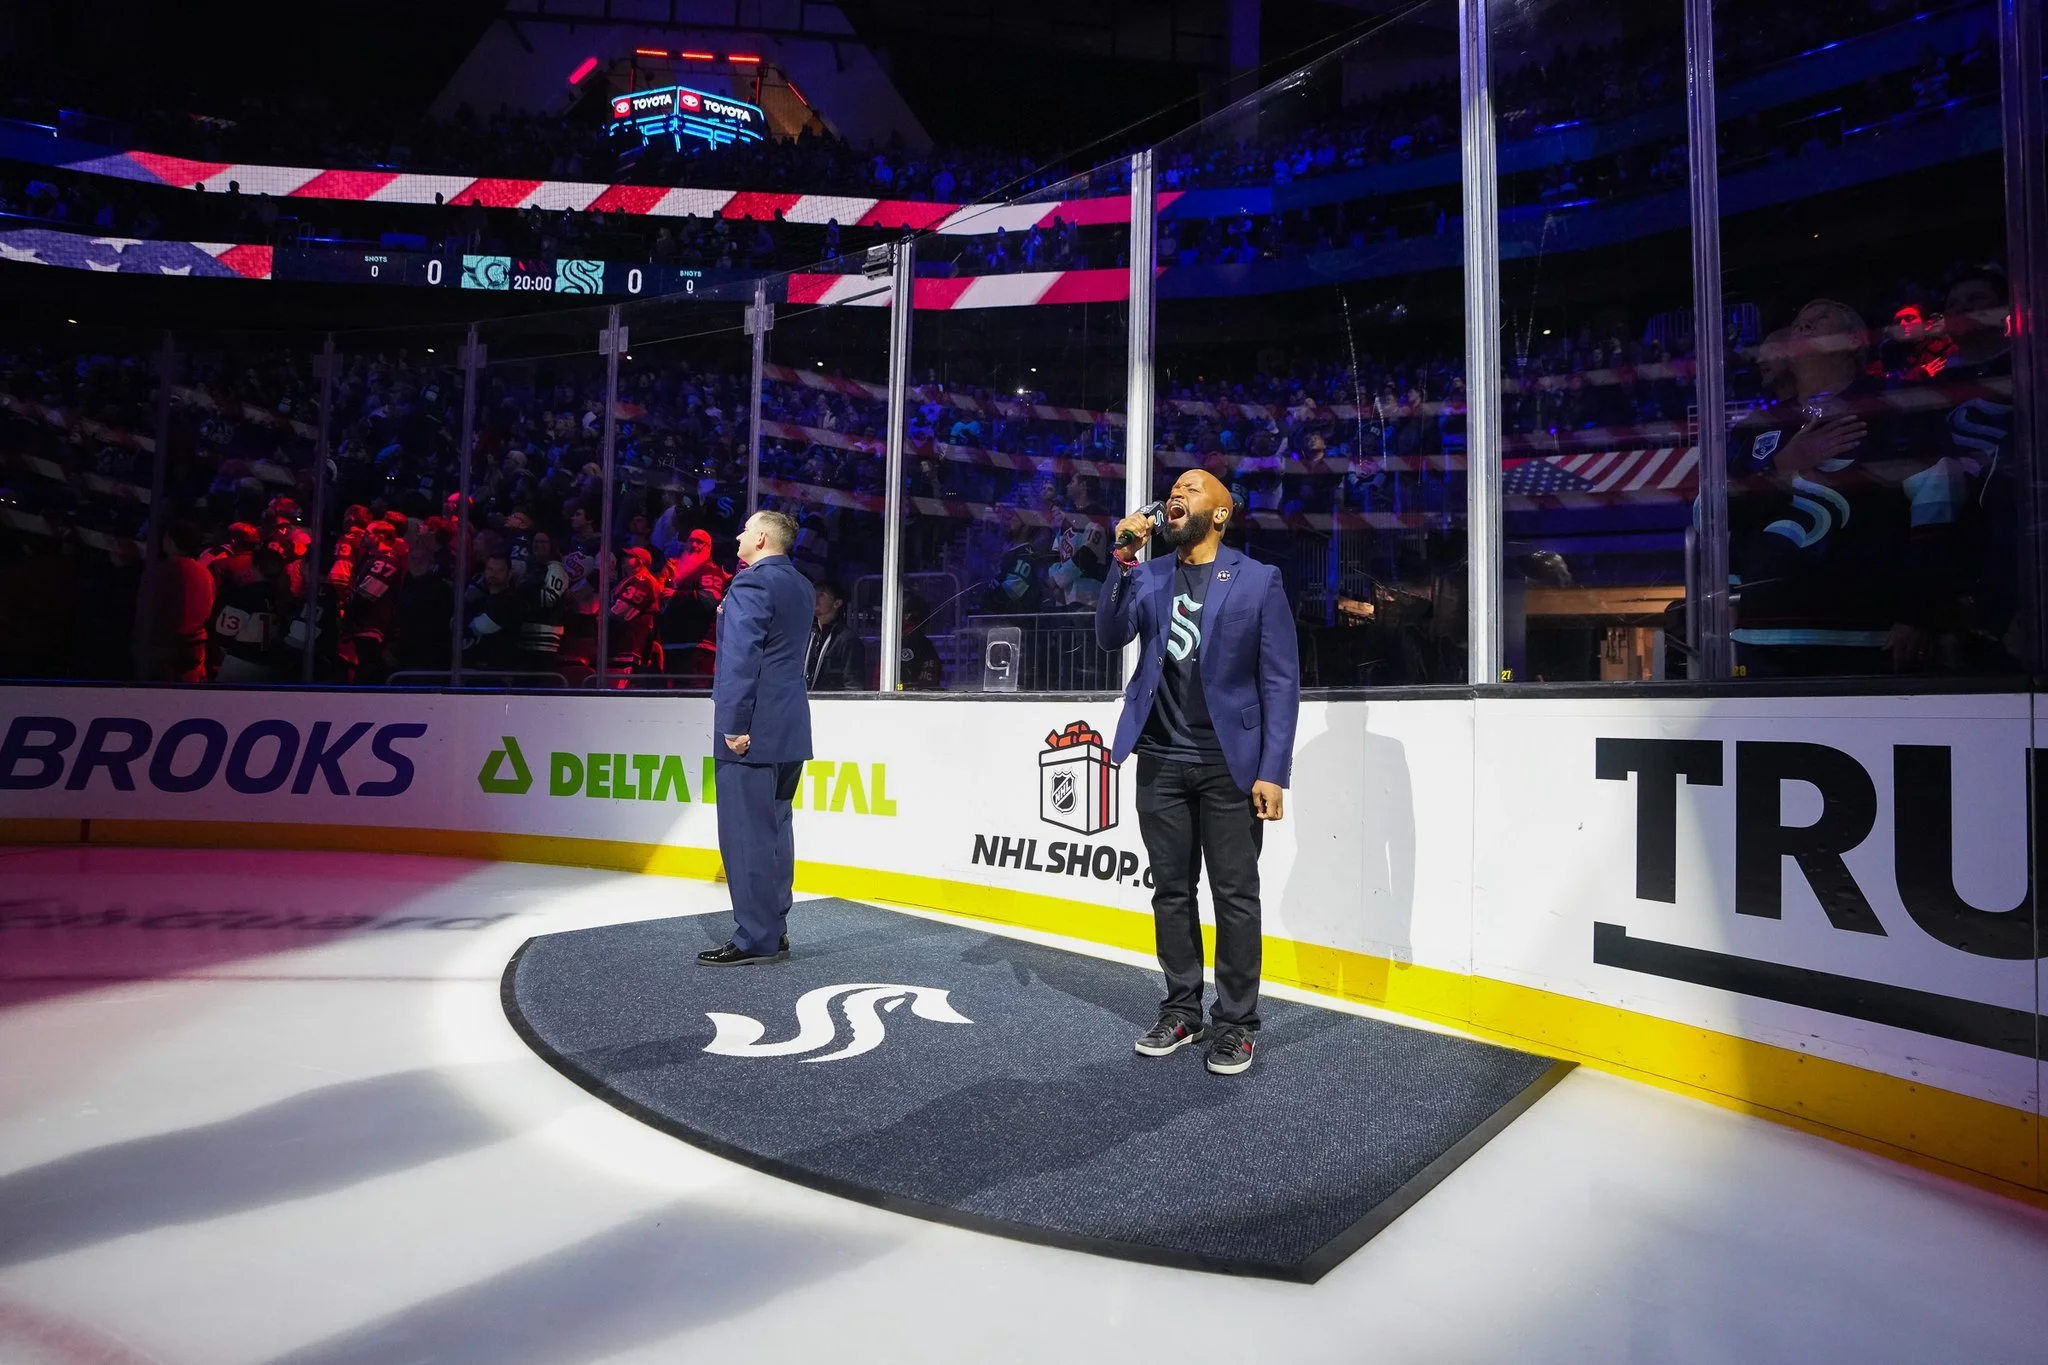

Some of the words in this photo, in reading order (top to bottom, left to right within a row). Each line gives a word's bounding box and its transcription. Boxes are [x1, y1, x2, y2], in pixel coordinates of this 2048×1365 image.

[632, 94, 673, 111] TOYOTA
[703, 99, 751, 122] TOYOTA
[364, 255, 388, 263] SHOTS
[371, 265, 379, 278] 0
[427, 259, 442, 285] 0
[679, 269, 702, 278] SHOTS
[513, 274, 552, 292] 20:00
[628, 268, 642, 294] 0
[686, 279, 694, 292] 0
[370, 560, 397, 578] 37
[1014, 559, 1032, 578] 10
[551, 575, 563, 591] 10
[220, 613, 240, 630] 13
[1501, 670, 1512, 681] 27
[0, 716, 428, 797] BROOKS
[549, 751, 692, 803] DELTA
[701, 756, 897, 817] TAL
[1054, 780, 1072, 805] NHL
[1595, 737, 2048, 961] TRU
